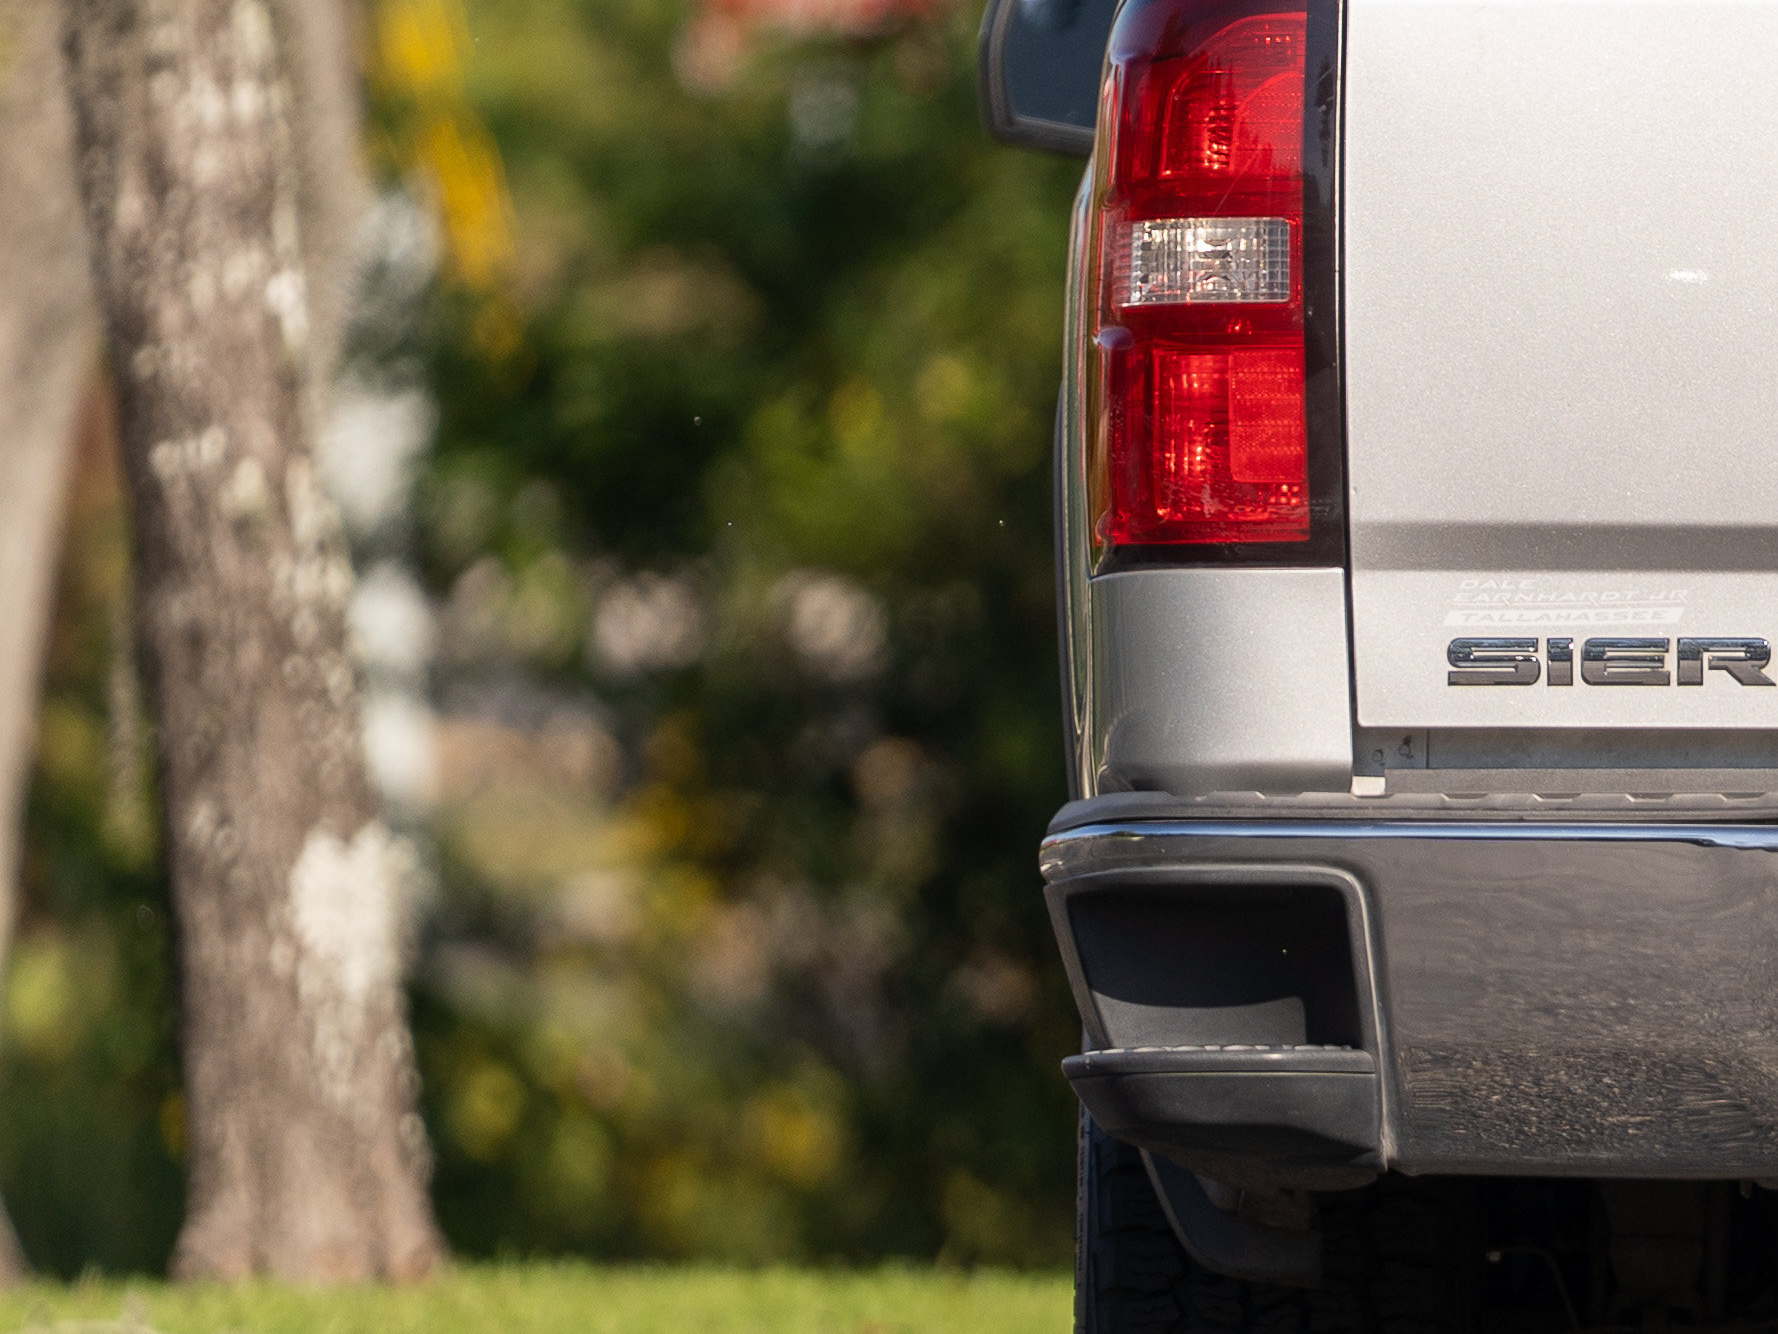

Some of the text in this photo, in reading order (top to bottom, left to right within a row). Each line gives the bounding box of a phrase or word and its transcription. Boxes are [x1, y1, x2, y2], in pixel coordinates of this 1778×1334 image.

[1459, 579, 1536, 590] DALE
[1452, 590, 1640, 605] EARNHARDT
[1460, 610, 1669, 623] TALLAHASSEE
